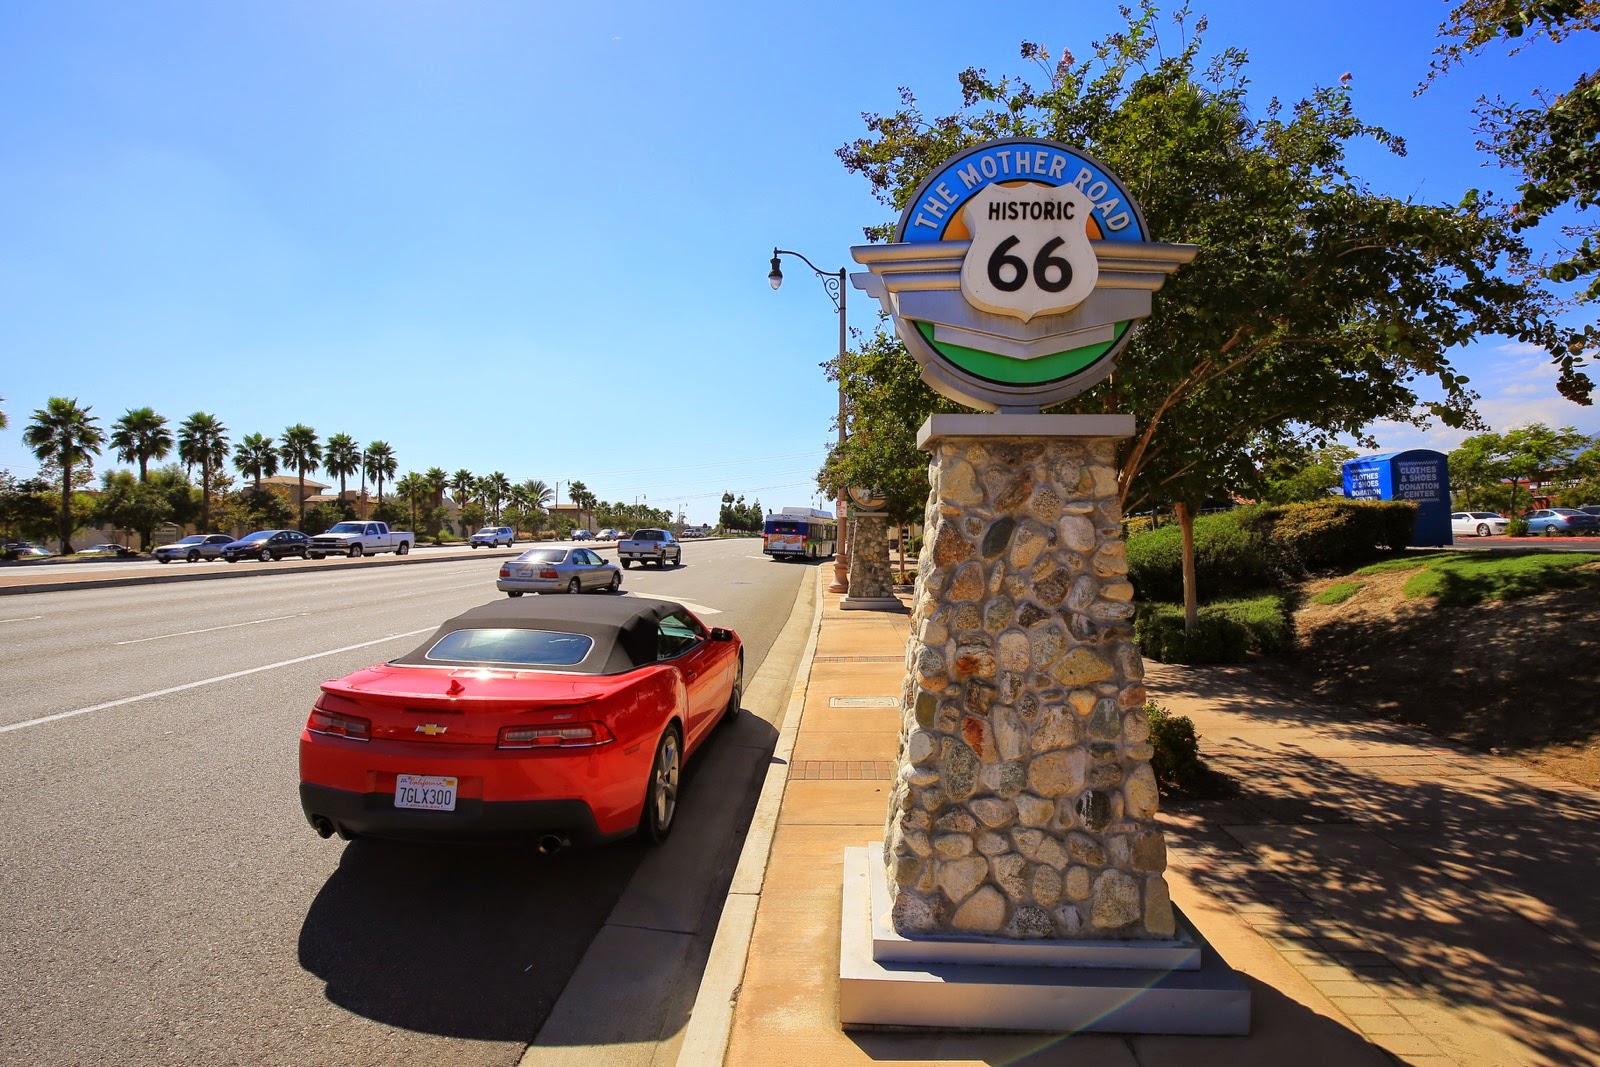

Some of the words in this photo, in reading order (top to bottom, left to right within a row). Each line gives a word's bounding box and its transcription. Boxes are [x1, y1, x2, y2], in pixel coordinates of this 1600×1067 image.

[914, 182, 959, 230] THE
[957, 150, 1067, 190] MOTHER
[1072, 168, 1131, 232] ROAD
[988, 201, 1075, 221] HISTORIC
[987, 235, 1073, 293] 66
[1400, 466, 1437, 475] CLOTHES
[1352, 472, 1379, 481] CLOTHES
[1409, 473, 1437, 482] SHOES
[1358, 480, 1379, 488] SHOES
[1399, 482, 1439, 491] DONATION
[1351, 488, 1382, 497] DONATION
[1403, 490, 1435, 498] CENTER
[409, 777, 446, 788] California
[400, 787, 452, 806] 7GLX300
